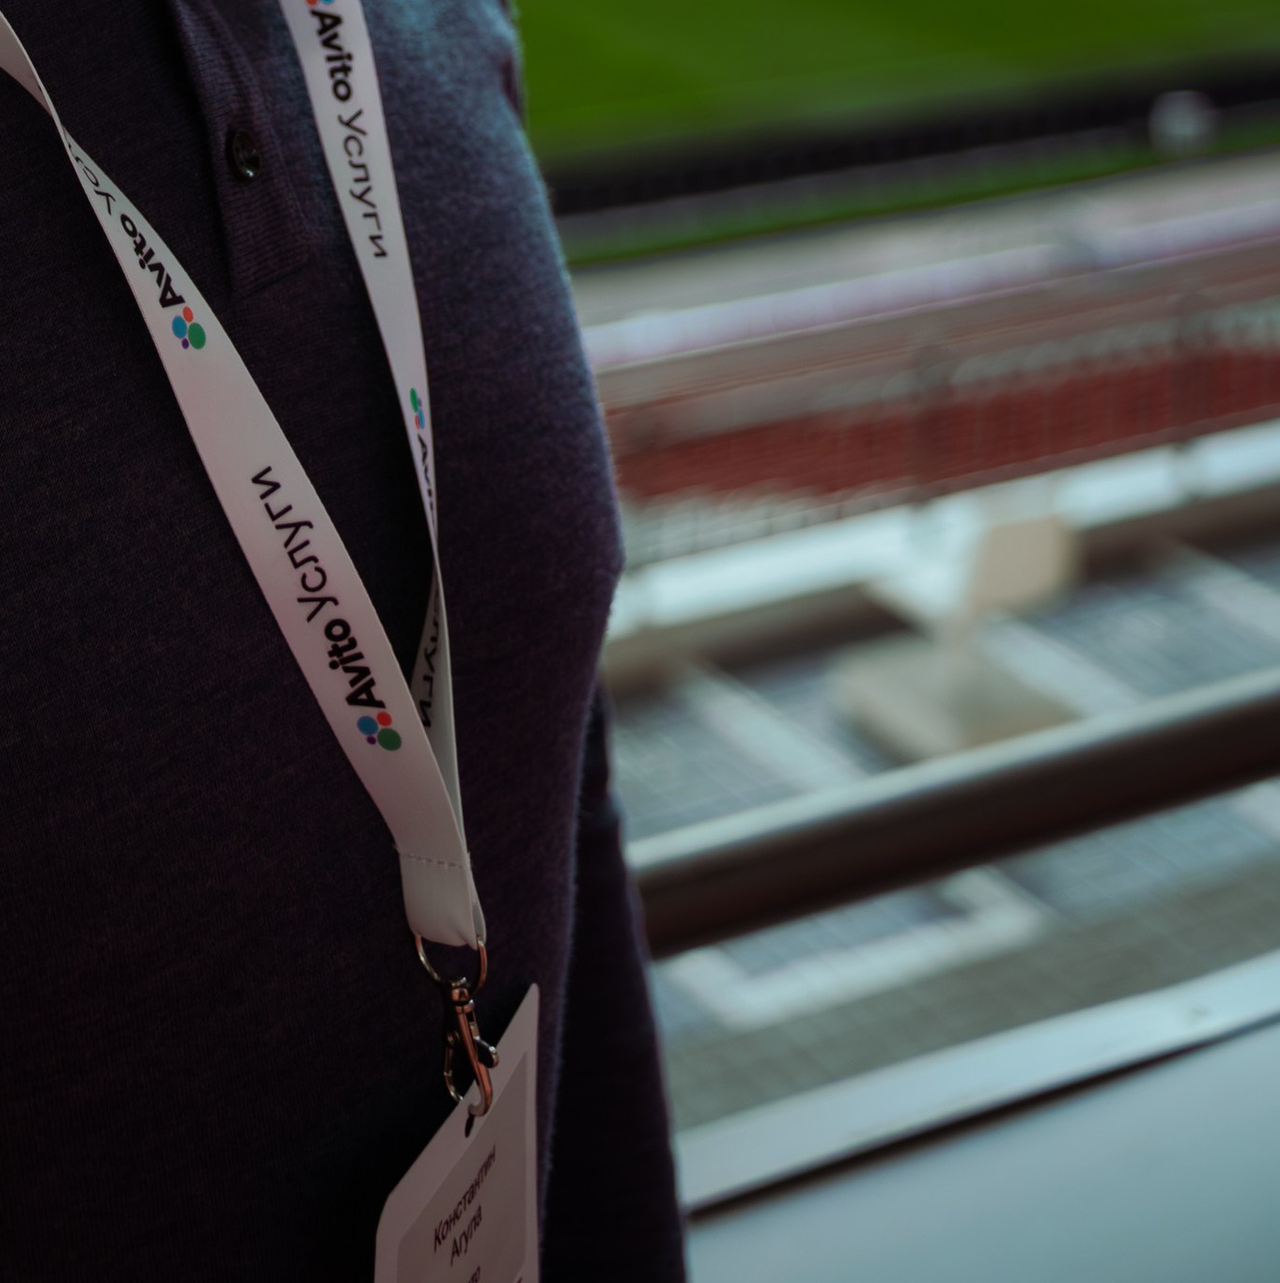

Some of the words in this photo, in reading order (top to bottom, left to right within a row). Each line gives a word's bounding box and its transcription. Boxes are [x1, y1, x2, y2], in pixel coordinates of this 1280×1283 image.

[312, 9, 353, 103] Avito
[337, 109, 388, 260] Услуги
[120, 213, 185, 309] Avito
[251, 466, 339, 622] Услуги
[323, 618, 386, 709] Avito
[433, 1143, 496, 1253] Константин
